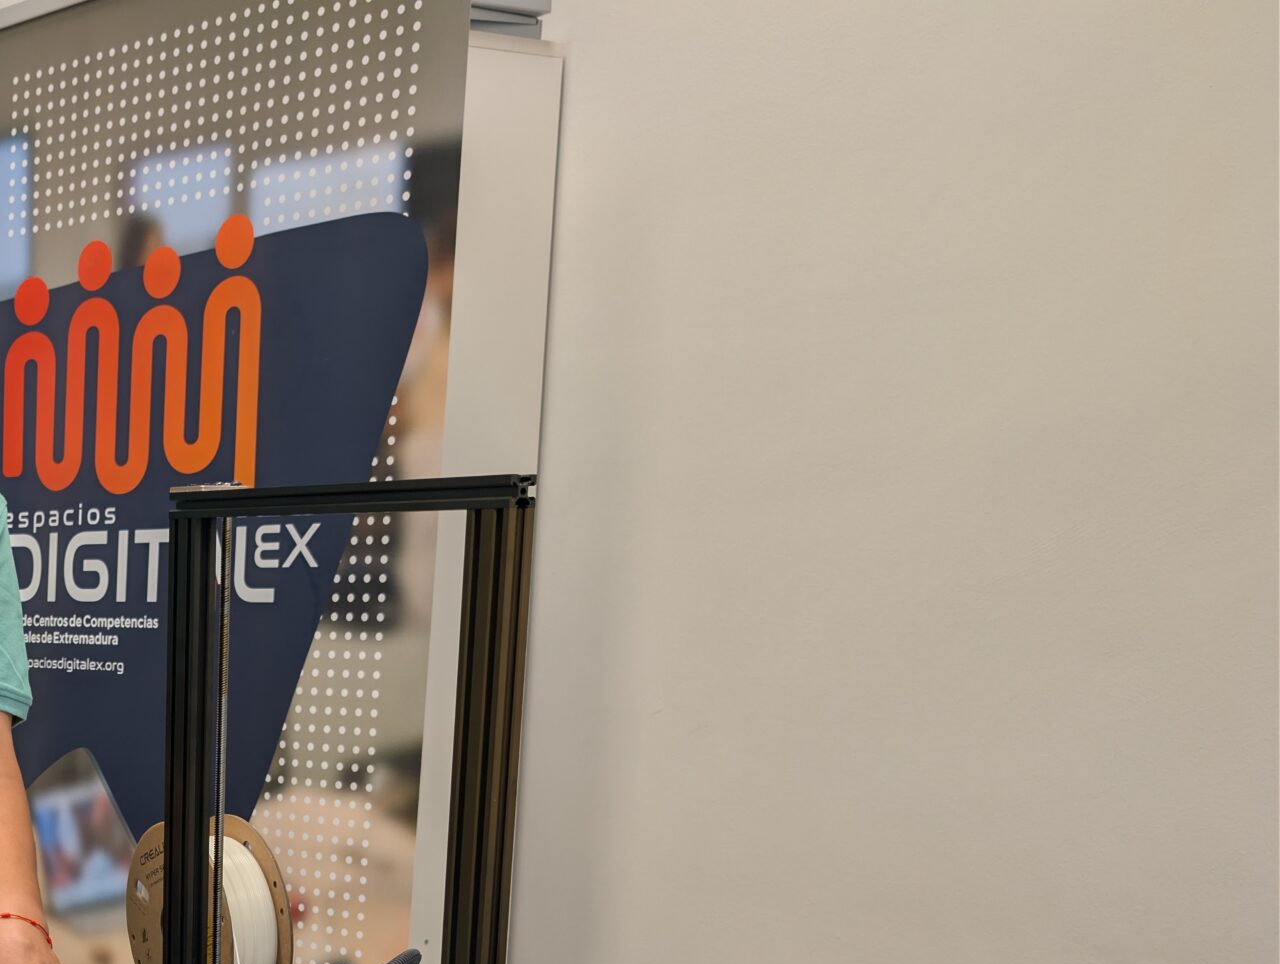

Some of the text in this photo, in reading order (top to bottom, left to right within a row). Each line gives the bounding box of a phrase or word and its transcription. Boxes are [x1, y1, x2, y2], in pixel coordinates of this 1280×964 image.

[7, 503, 116, 533] espacios
[9, 523, 320, 603] DIGITLEX
[33, 614, 68, 627] Centros
[69, 614, 82, 627] de
[83, 614, 159, 629] Competencias
[41, 632, 52, 644] de
[53, 632, 119, 645] Extremadura
[27, 657, 125, 675] paciosdigitalex.org
[140, 842, 164, 866] CREAL
